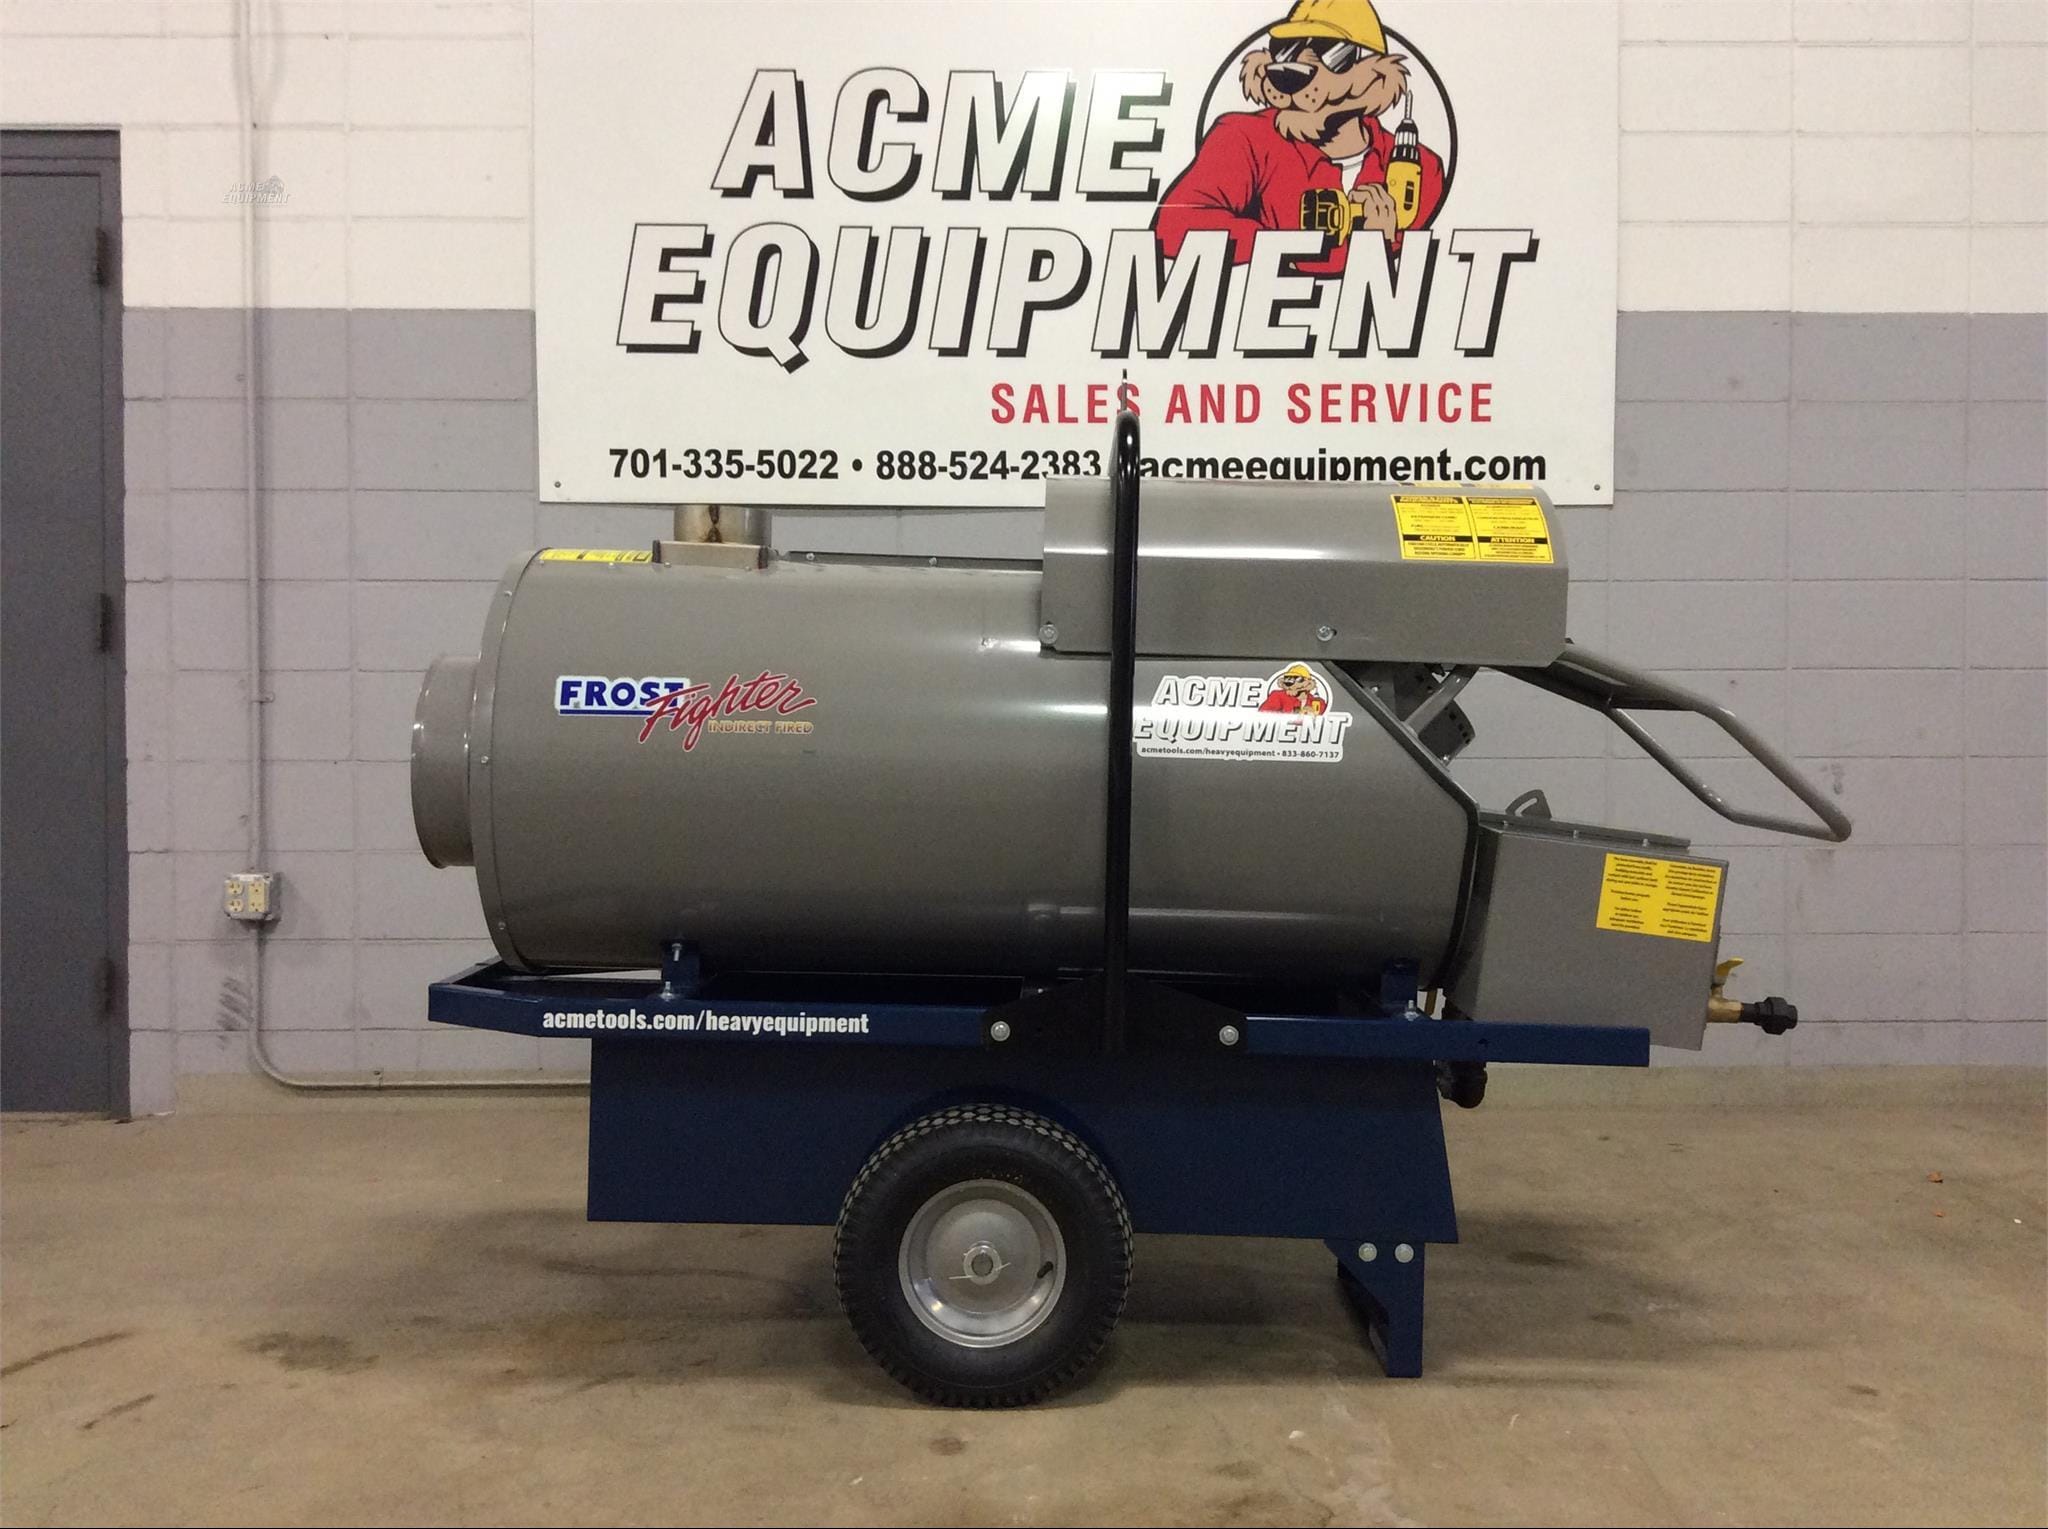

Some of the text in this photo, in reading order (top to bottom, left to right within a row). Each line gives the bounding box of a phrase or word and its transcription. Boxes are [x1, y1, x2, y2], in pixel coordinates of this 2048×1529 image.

[711, 66, 1174, 202] ACME
[616, 222, 1541, 374] EQUIPMENT
[990, 382, 1494, 424] SALES AND SERVICE
[609, 448, 1547, 481] 701-335-5022 888-524-2383 acmeequipment.com
[1420, 534, 1456, 542] CAUTION
[1490, 536, 1535, 544] ATTENTION
[1157, 677, 1262, 708] ACME
[560, 670, 817, 751] FROST Fighter
[708, 719, 814, 734] INDIRECT FIRED
[1134, 712, 1349, 745] EQUIPMENT
[1141, 746, 1340, 760] acmetools.com/heavyequipment 833-860-7137
[543, 1009, 869, 1036] acmetools.com/heavyequipment
